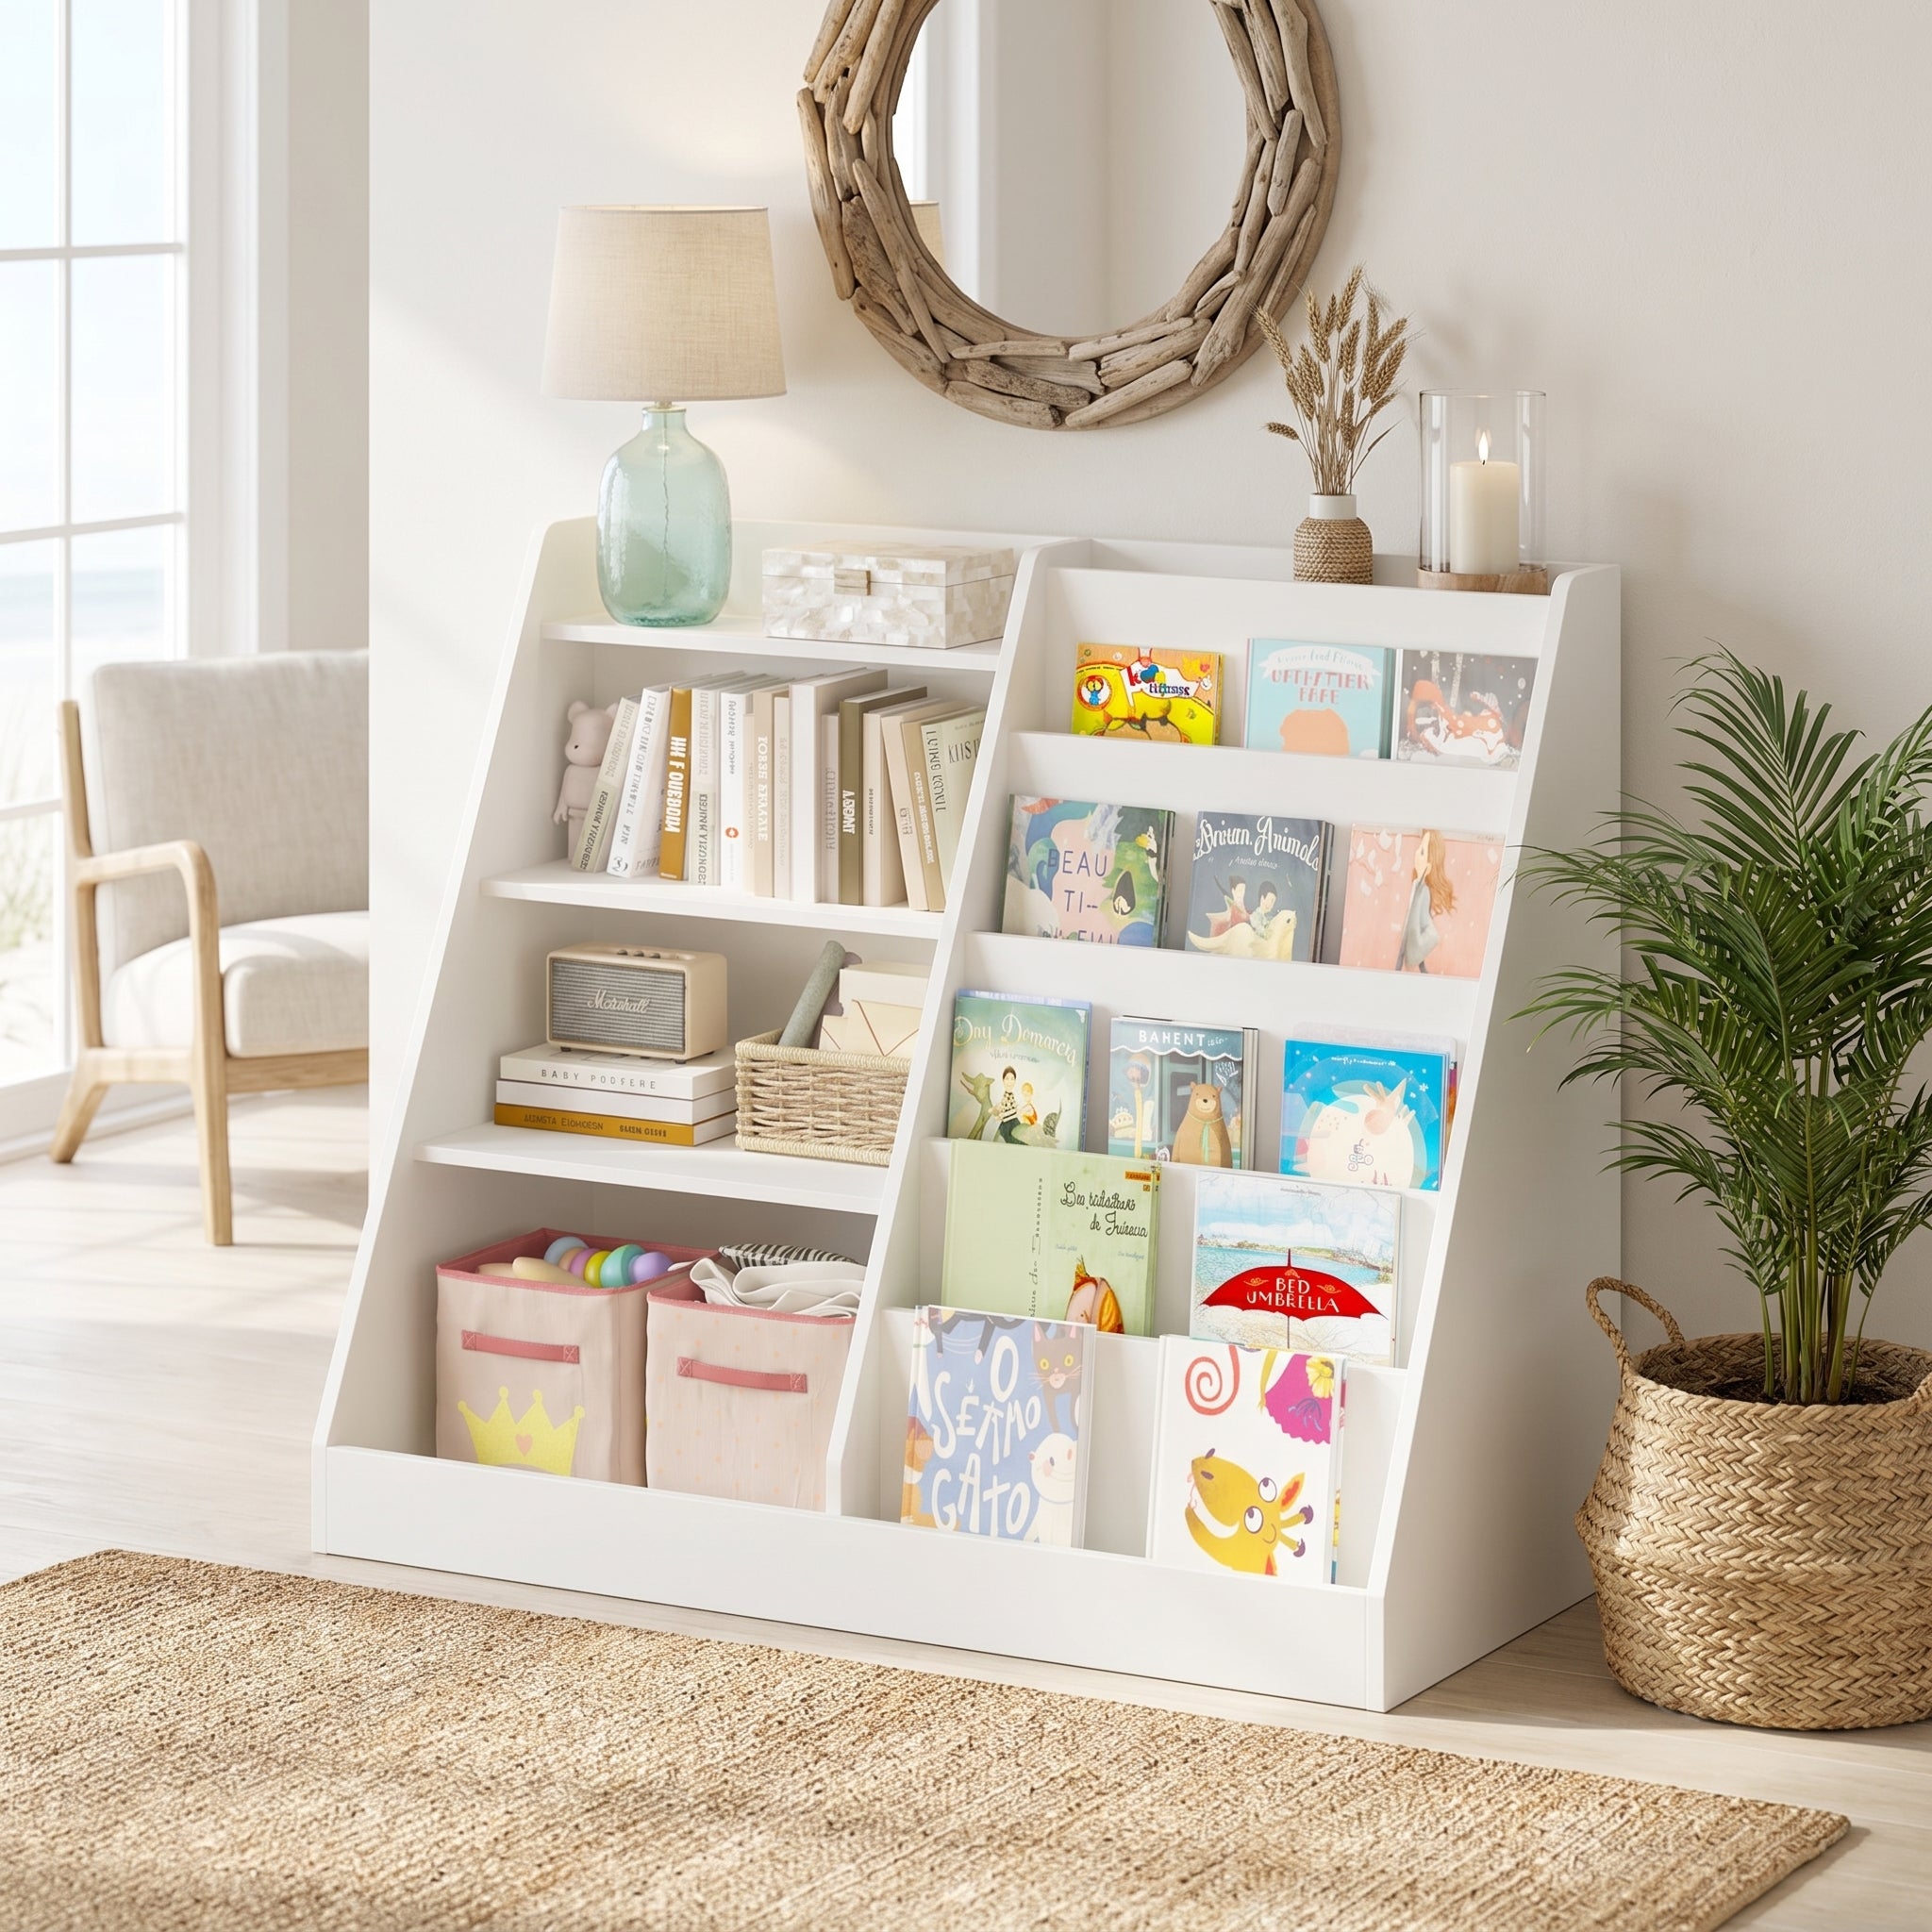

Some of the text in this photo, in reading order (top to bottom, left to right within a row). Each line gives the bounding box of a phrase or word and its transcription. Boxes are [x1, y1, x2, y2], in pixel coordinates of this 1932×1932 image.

[1047, 849, 1108, 877] BEAU
[541, 1069, 579, 1081] BABY
[1246, 1291, 1340, 1313] UMBRELLA
[931, 1453, 1031, 1538] GATO
